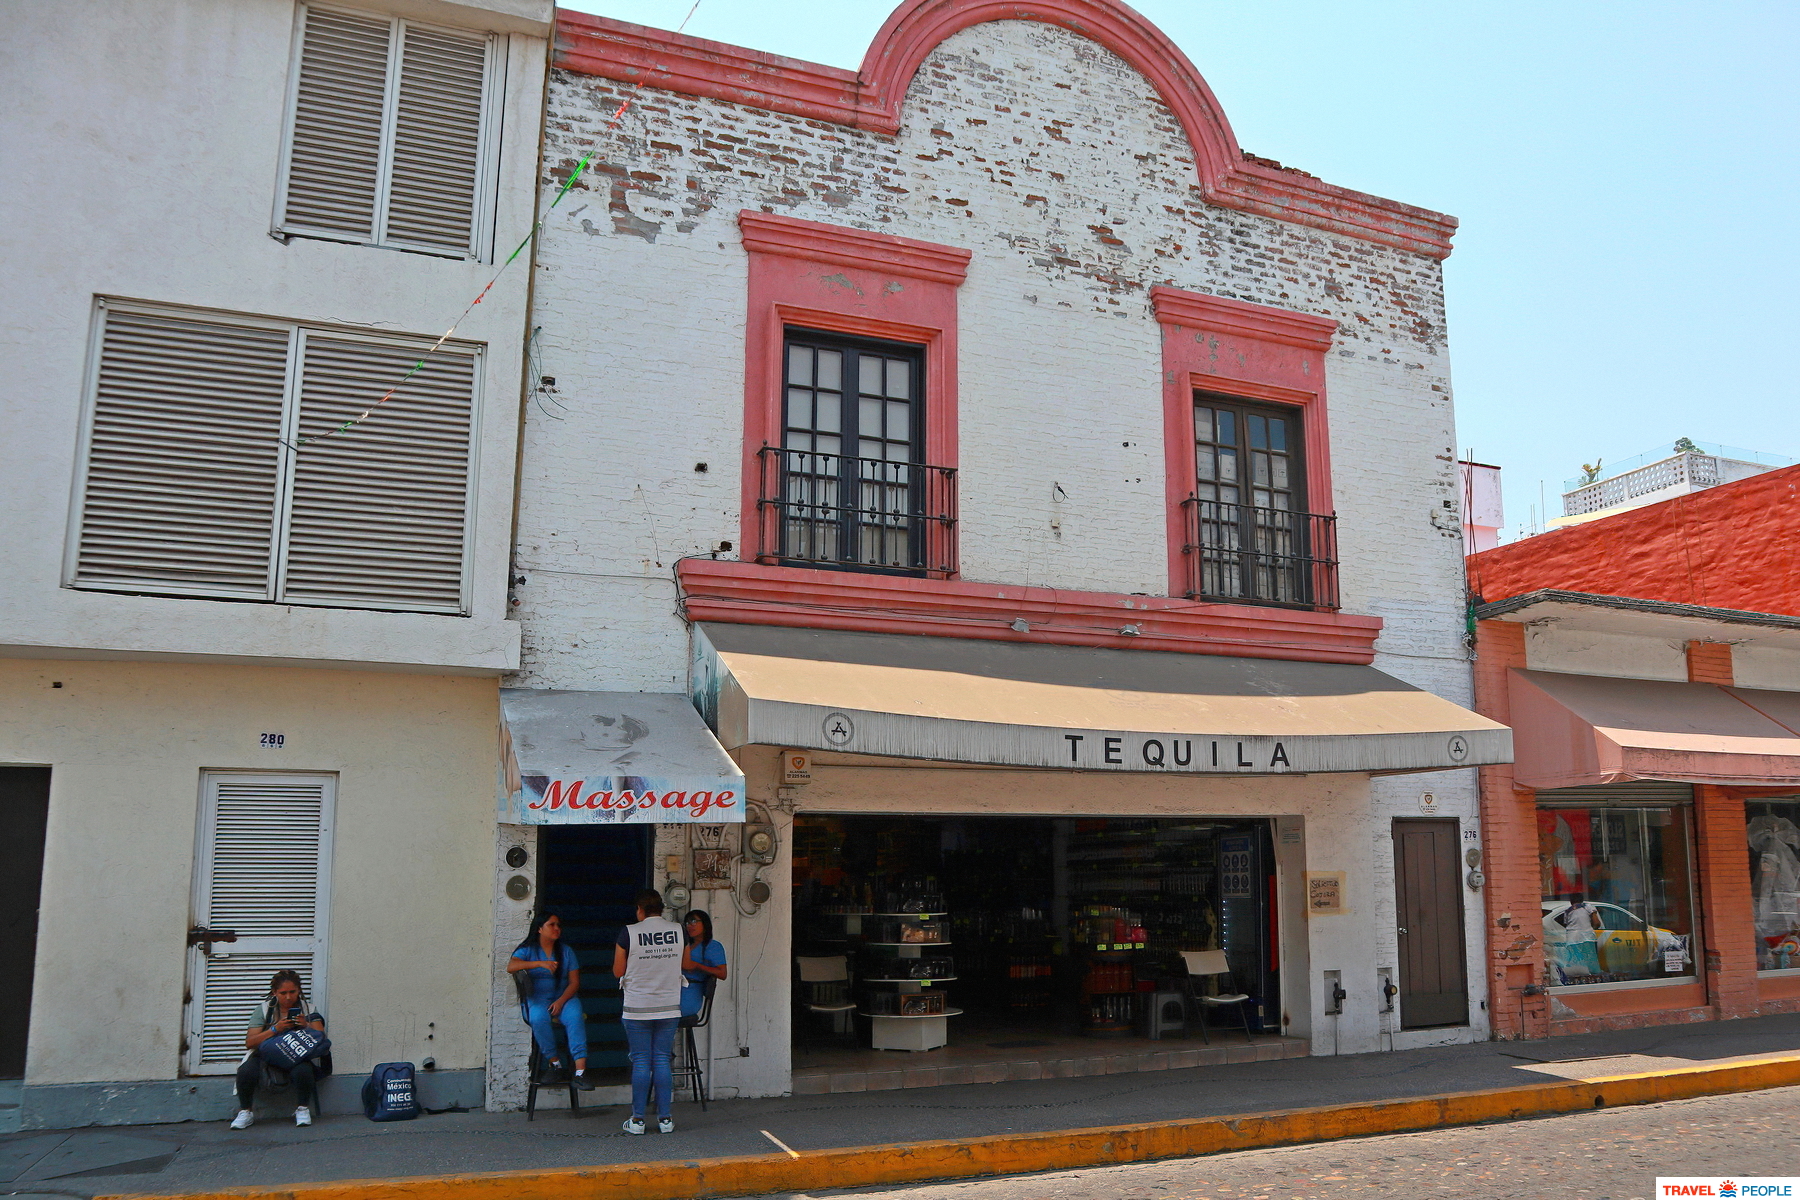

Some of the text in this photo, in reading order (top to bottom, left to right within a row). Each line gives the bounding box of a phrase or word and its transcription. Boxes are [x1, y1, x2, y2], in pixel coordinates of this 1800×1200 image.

[260, 733, 285, 745] 280
[1064, 734, 1291, 769] TEQUILA
[528, 780, 737, 818] Massage
[1464, 830, 1477, 839] 276
[638, 931, 679, 946] INEGI
[282, 1033, 308, 1057] INEGI
[387, 1083, 412, 1091] México
[387, 1092, 412, 1102] INEG
